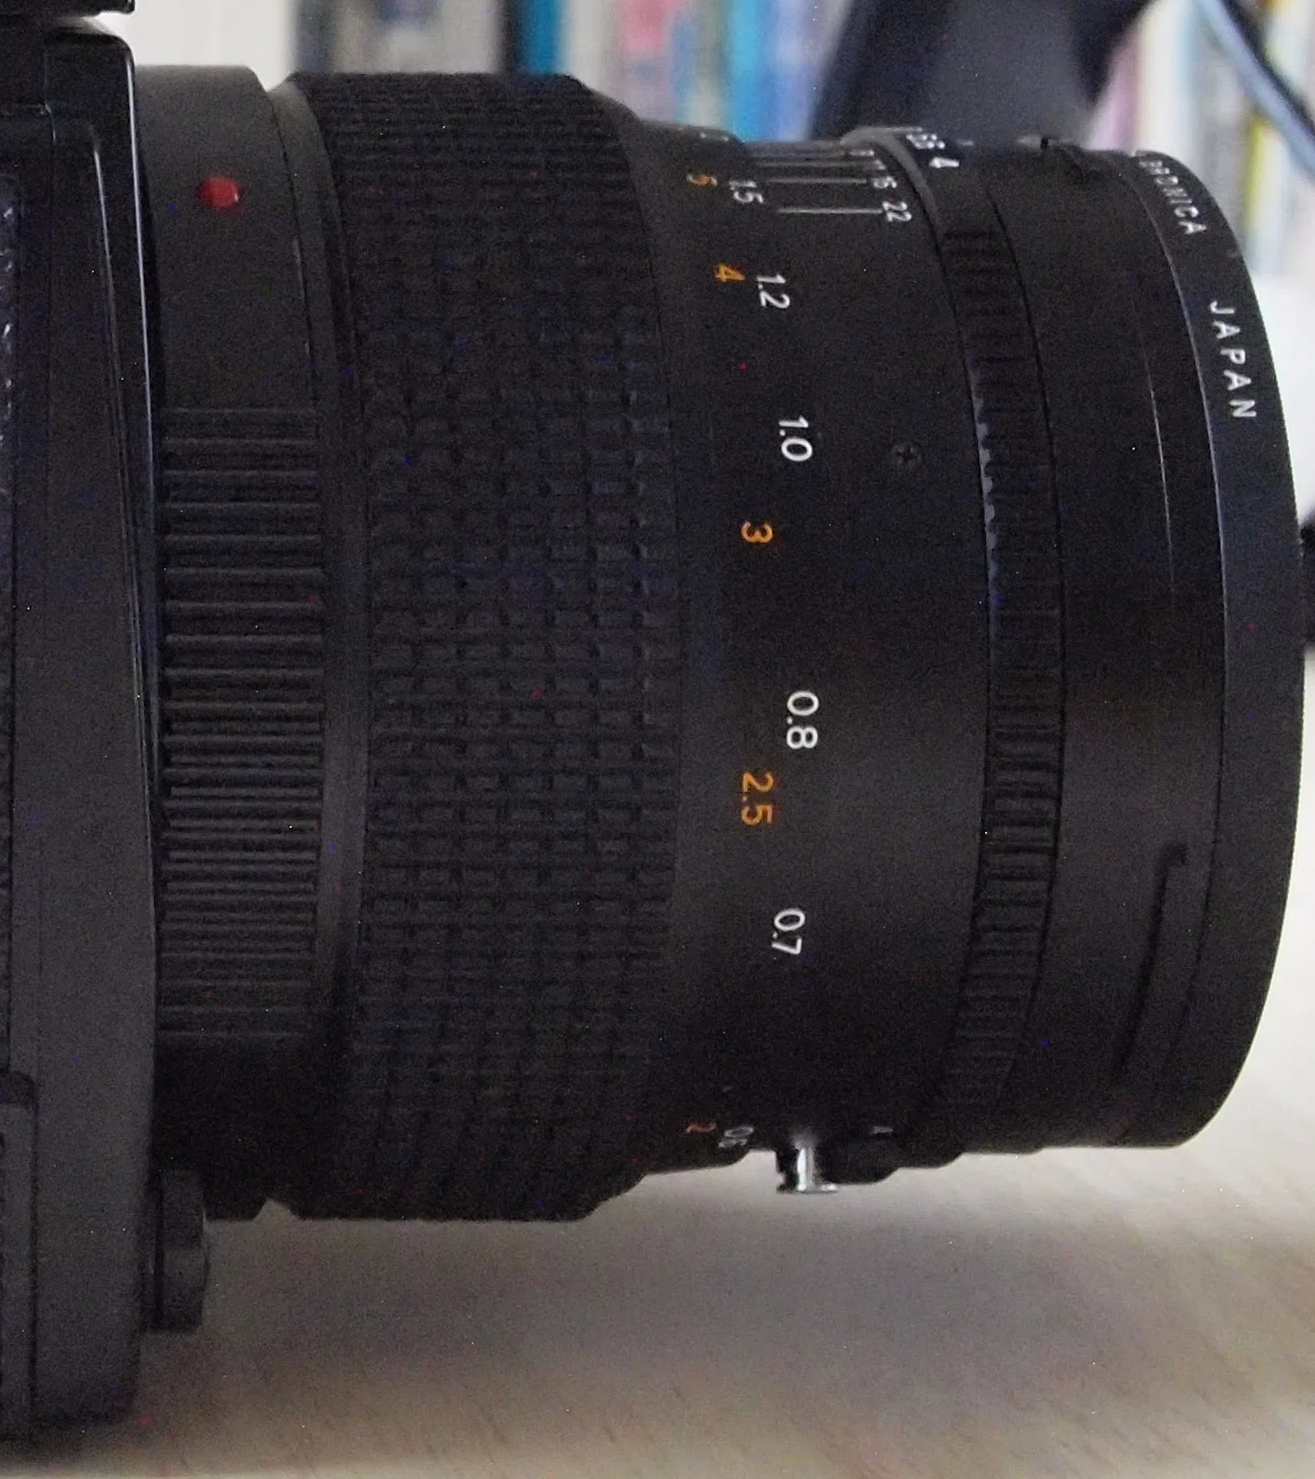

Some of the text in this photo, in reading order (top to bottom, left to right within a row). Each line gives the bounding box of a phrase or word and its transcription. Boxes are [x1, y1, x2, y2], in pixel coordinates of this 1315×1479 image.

[881, 201, 913, 222] 22
[714, 263, 746, 283] 4
[756, 273, 791, 310] 1.2
[1209, 300, 1258, 418] JAPAN
[778, 415, 813, 462] 1.0
[740, 520, 774, 544] 3
[786, 690, 820, 750] 0.8
[740, 771, 774, 826] 2.5
[771, 907, 806, 955] 0.7
